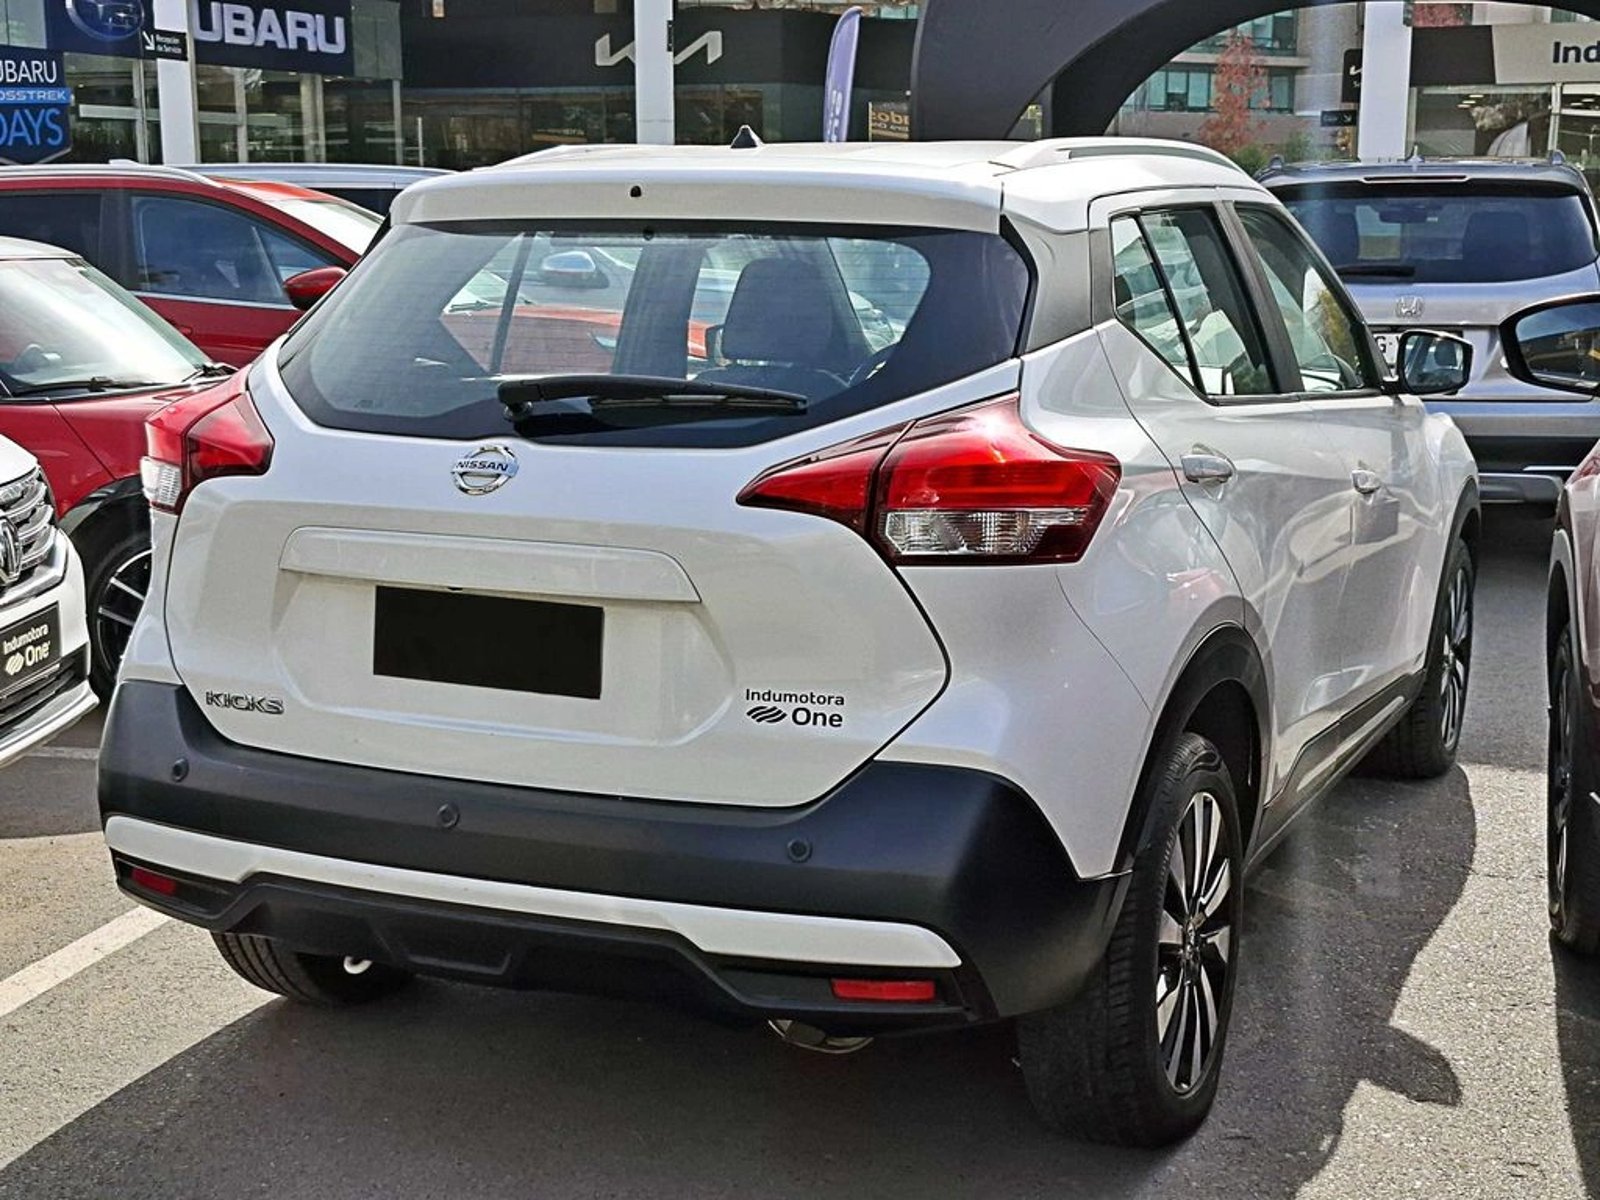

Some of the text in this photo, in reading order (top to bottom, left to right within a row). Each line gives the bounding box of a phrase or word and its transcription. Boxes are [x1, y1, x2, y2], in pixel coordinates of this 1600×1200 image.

[193, 0, 346, 54] UBARU
[1553, 40, 1600, 63] Ind
[0, 60, 57, 84] BARU
[455, 460, 509, 472] NISSAN
[3, 624, 49, 655] Indumotora
[25, 641, 50, 667] One
[206, 690, 285, 715] KICKS
[745, 688, 845, 706] Indumotora
[791, 706, 843, 728] One
